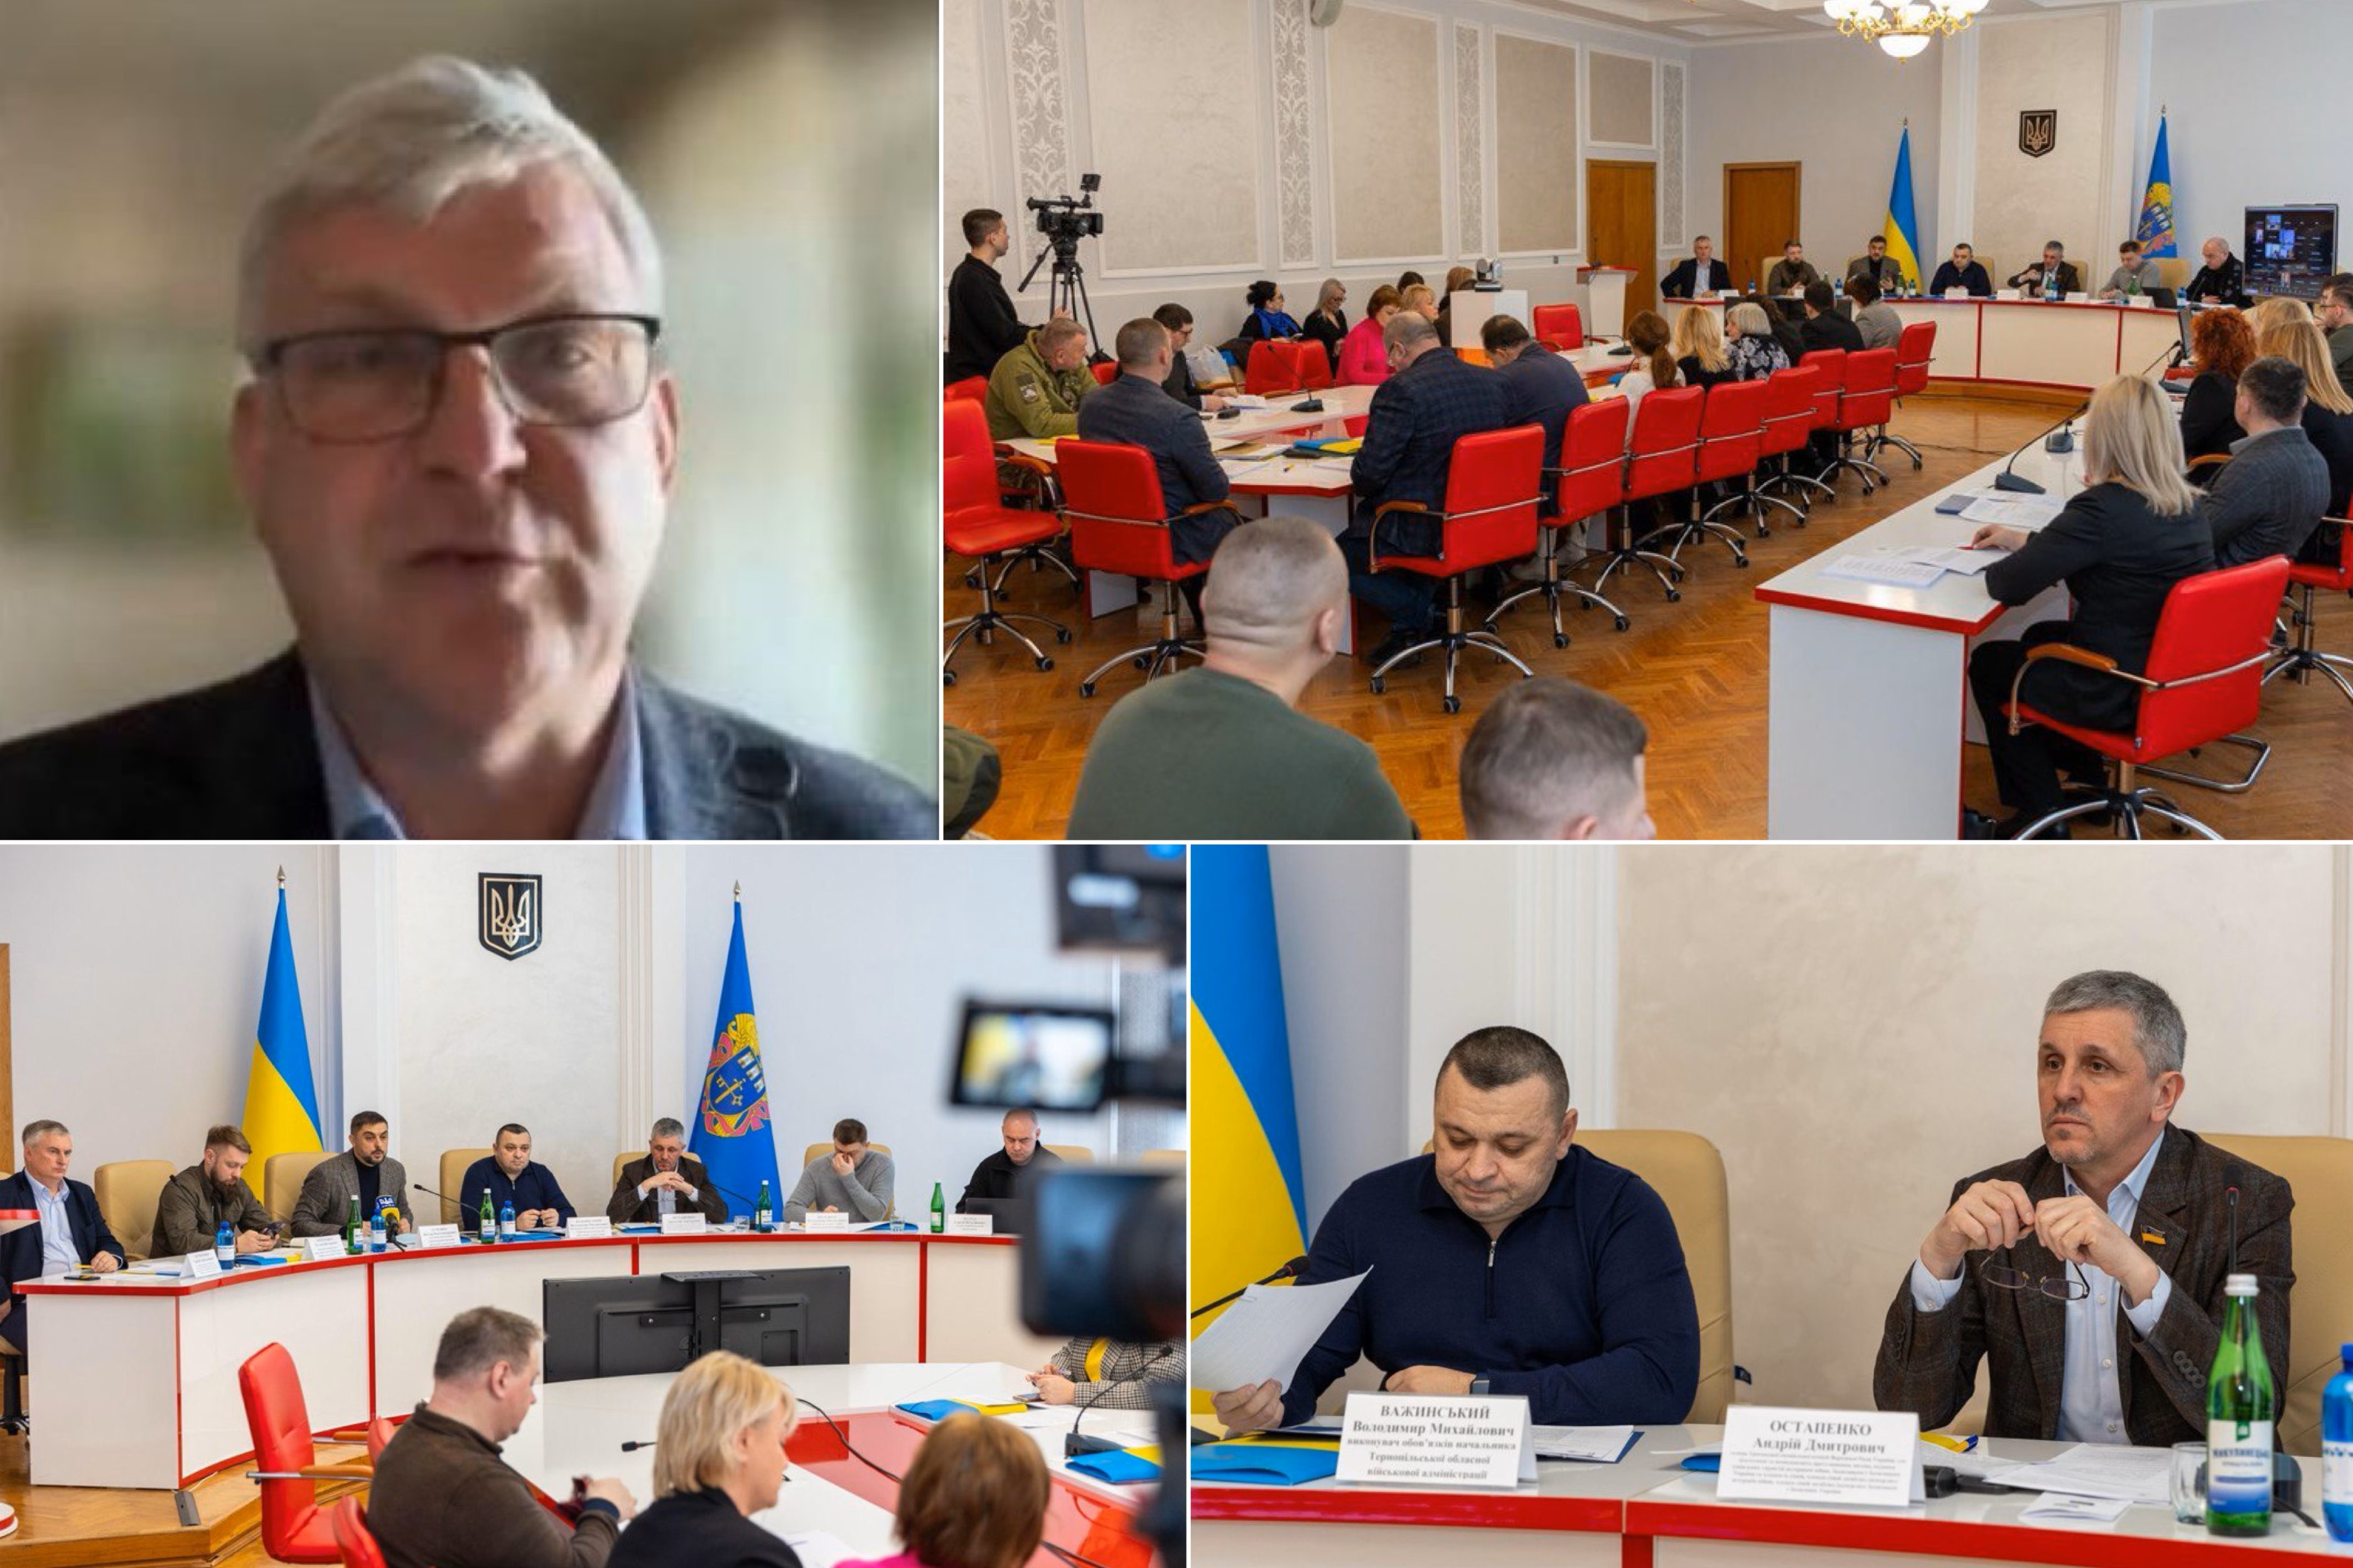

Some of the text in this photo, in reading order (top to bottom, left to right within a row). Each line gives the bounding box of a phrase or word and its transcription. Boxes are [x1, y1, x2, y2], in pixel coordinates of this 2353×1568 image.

[1381, 1405, 1490, 1419] ВАЖИНСЬКИЙ
[1353, 1420, 1515, 1437] Володимир Михайлович
[1770, 1420, 1871, 1436] ОСТАПЕНКО
[1347, 1438, 1400, 1450] виконувач
[1455, 1441, 1516, 1450] начальника
[1753, 1437, 1885, 1454] Андрій Дмитрович
